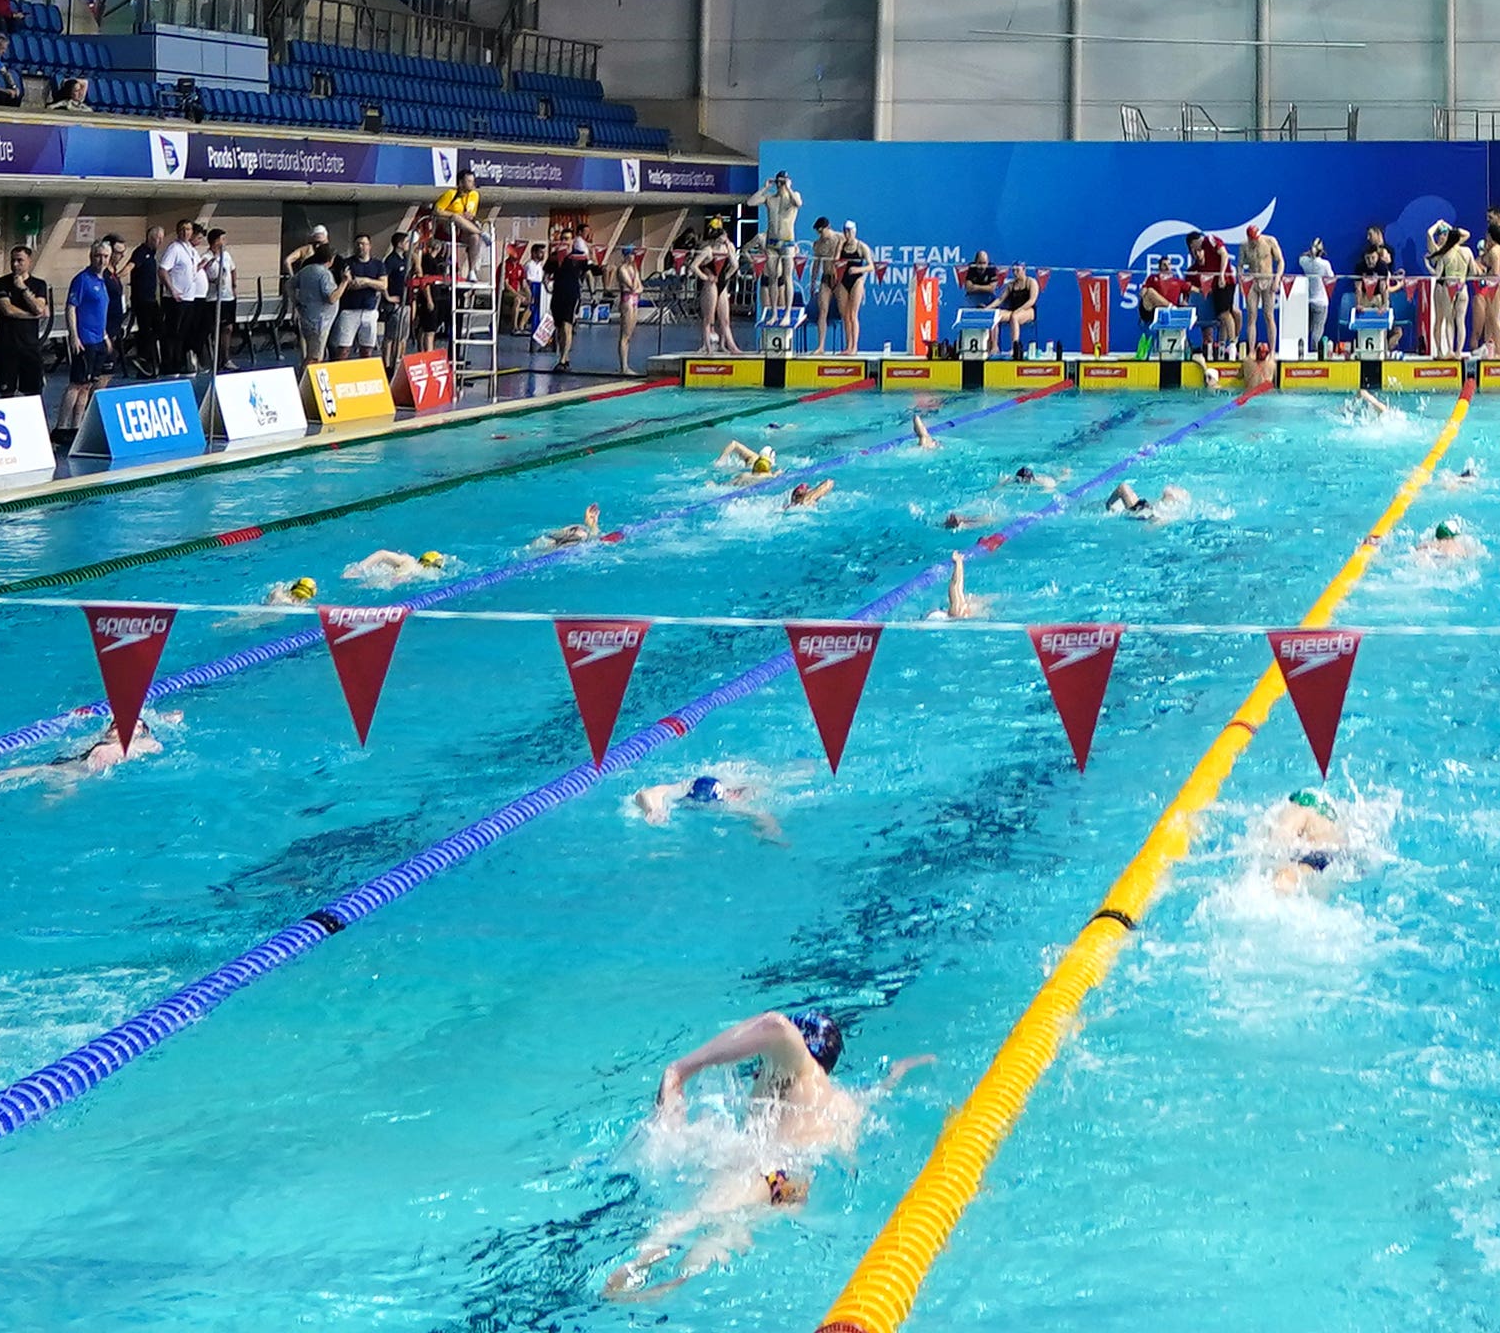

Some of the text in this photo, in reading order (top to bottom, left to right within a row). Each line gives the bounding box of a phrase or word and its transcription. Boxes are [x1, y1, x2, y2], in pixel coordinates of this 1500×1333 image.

[208, 145, 233, 169] Ponds
[899, 245, 966, 263] TEAM.
[772, 336, 781, 352] 9
[969, 337, 978, 352] 8
[1167, 339, 1177, 353] 7
[1365, 337, 1375, 351] 6
[116, 396, 188, 443] LEBARA
[96, 614, 167, 635] speedo
[328, 606, 402, 626] speedo
[567, 627, 639, 650] speedo
[799, 632, 874, 657] speedo
[1041, 628, 1115, 652] speedo
[1280, 633, 1354, 660] speedo
